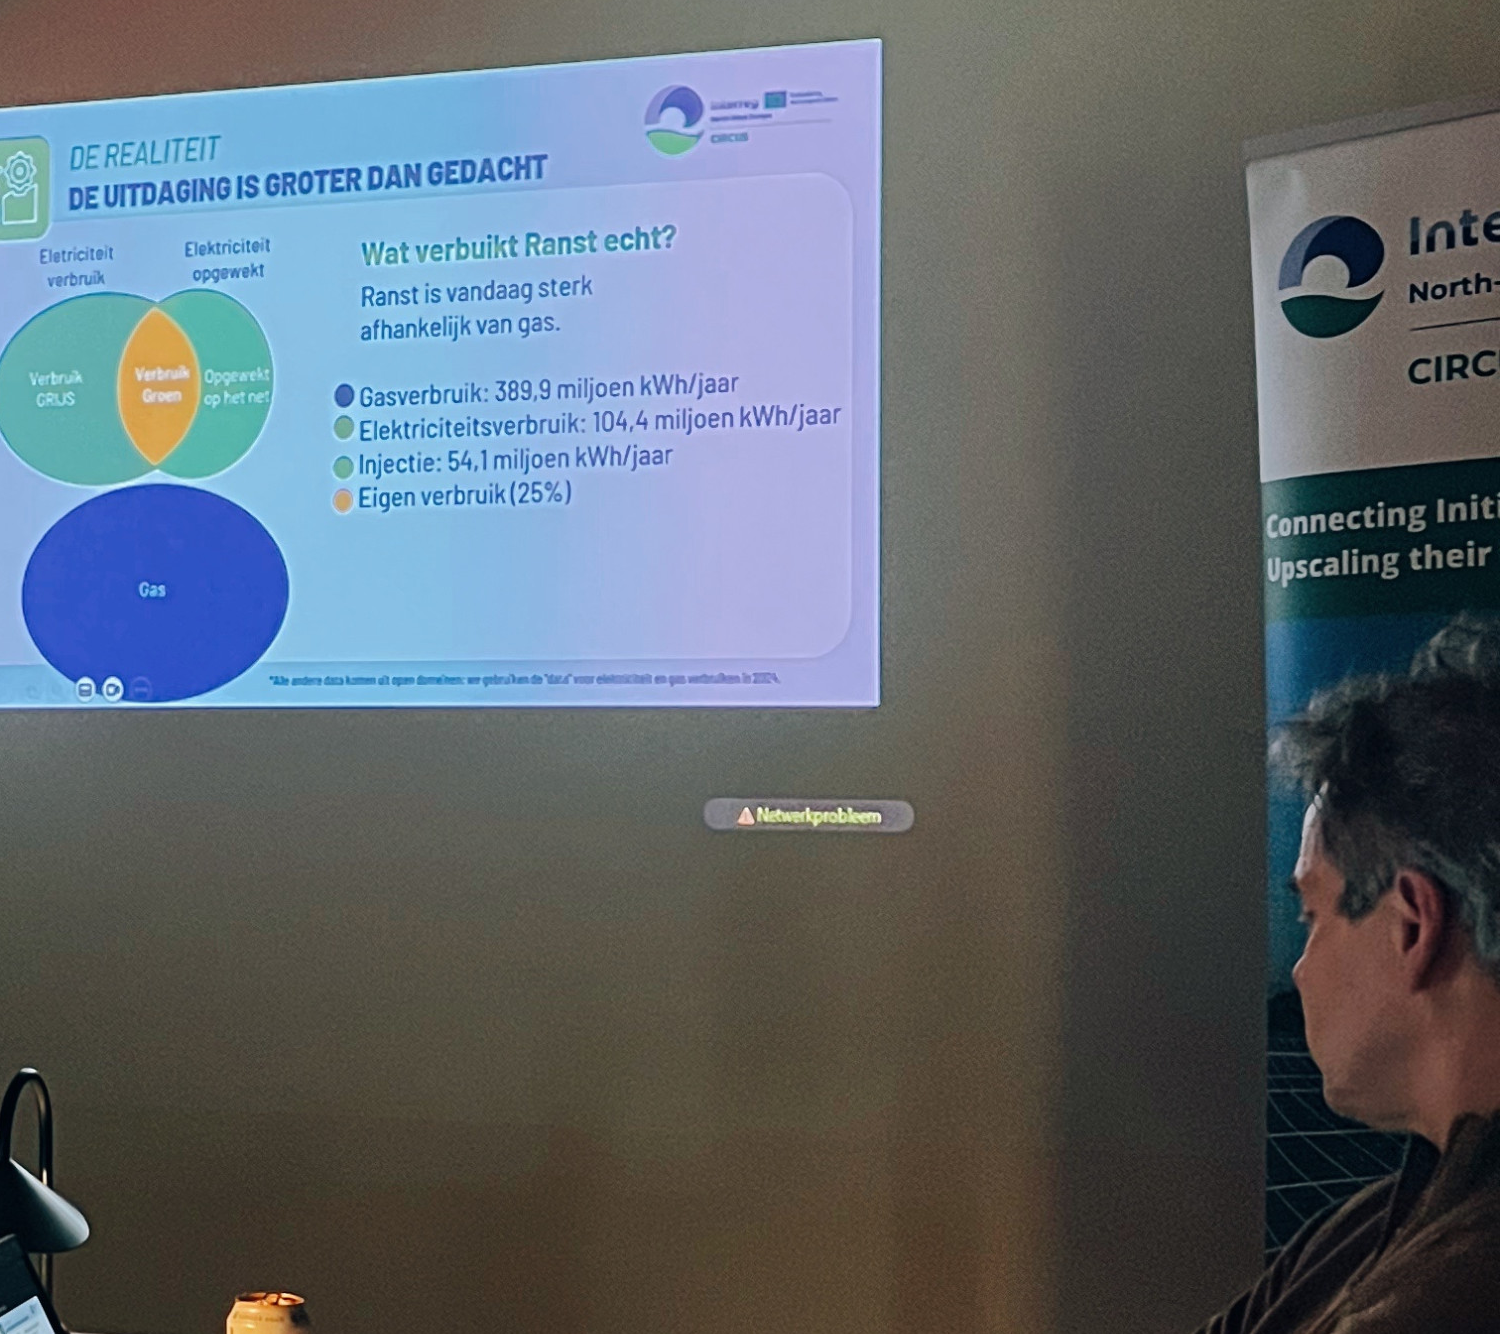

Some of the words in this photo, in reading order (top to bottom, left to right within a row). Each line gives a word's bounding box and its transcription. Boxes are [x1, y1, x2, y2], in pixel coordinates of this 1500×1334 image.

[70, 144, 100, 171] DE
[104, 135, 222, 168] REALITEIT
[68, 185, 99, 211] DE
[104, 176, 231, 208] UITDAGING
[236, 175, 260, 200] IS
[265, 164, 361, 198] GROTER
[368, 160, 421, 190] DAN
[426, 154, 548, 187] GEDACHT
[184, 237, 271, 258] Elektriciteit
[362, 242, 410, 266] Wat
[416, 233, 518, 263] verbuikt
[525, 230, 597, 259] Ranst
[604, 224, 677, 254] echt?
[1410, 209, 1500, 255] Inte
[47, 271, 106, 288] verbruik
[192, 263, 265, 284] opgewekt
[361, 282, 418, 307] Ranst
[424, 282, 442, 305] is
[446, 277, 533, 307] vandaag
[538, 275, 593, 299] sterk
[360, 316, 471, 342] afhankelijk
[476, 317, 512, 336] van
[518, 314, 561, 340] gas.
[204, 367, 270, 386] Opgewekt
[1408, 350, 1500, 384] CIRC
[204, 393, 221, 409] op
[223, 390, 245, 405] het
[248, 390, 270, 404] net
[359, 382, 489, 409] Gasverbruik:
[494, 378, 551, 405] 389,9
[557, 375, 634, 404] miljoen
[640, 372, 739, 399] kWh/jaar
[359, 412, 587, 443] Elektriciteitsverbruik:
[592, 410, 649, 436] 104,4
[654, 407, 734, 435] miljoen
[739, 404, 842, 432] kWh/jaar
[358, 449, 442, 479] Injectie:
[447, 449, 488, 474] 54,1
[493, 447, 570, 475] miljoen
[575, 444, 674, 470] kWh/jaar
[358, 485, 416, 514] Eigen
[422, 482, 505, 507] verbruik
[509, 479, 572, 506] (25%)
[1266, 501, 1427, 538] Connecting
[1267, 548, 1401, 588] Upscaling
[1409, 540, 1493, 571] their
[139, 581, 166, 598] Gas
[757, 807, 882, 827] Netwerkprobleem
